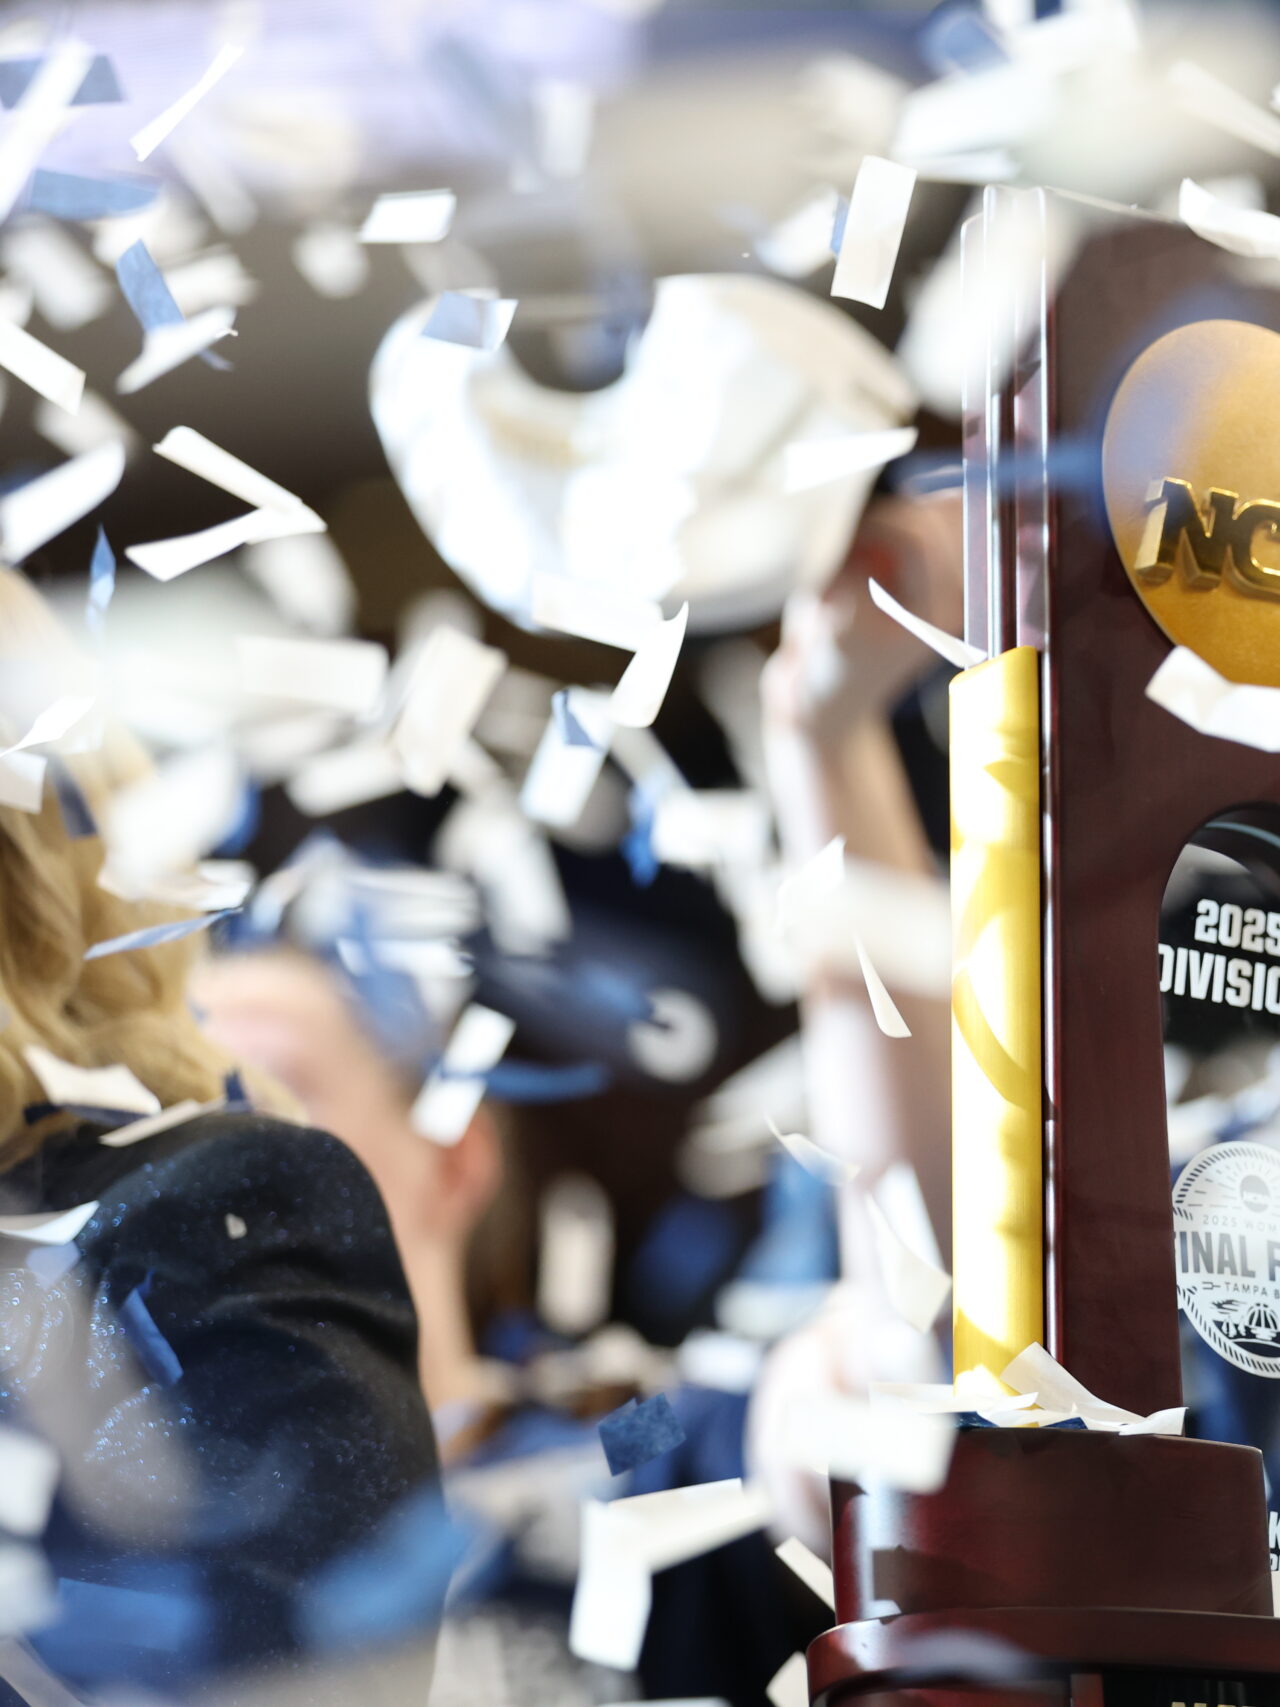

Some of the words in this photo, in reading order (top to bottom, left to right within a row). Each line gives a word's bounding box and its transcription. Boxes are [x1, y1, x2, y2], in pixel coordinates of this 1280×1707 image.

[1202, 1214, 1238, 1227] 2025
[1174, 1230, 1256, 1279] INAL
[1224, 1281, 1269, 1297] TAMPA
